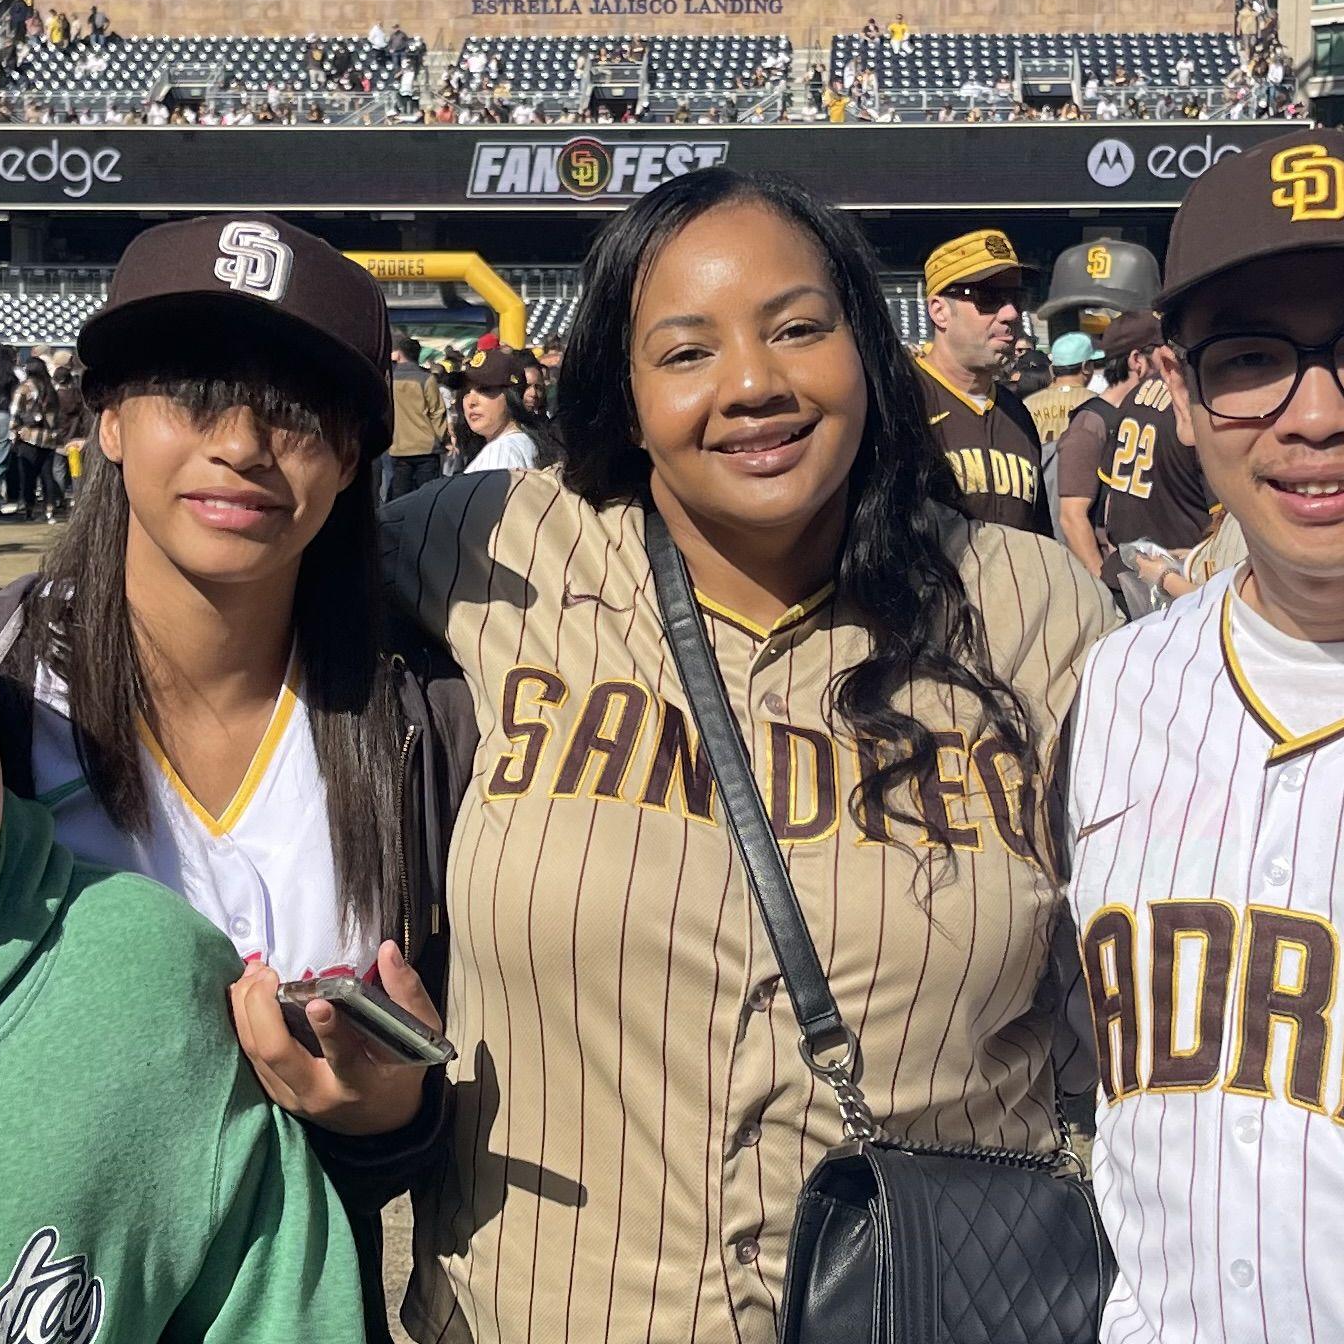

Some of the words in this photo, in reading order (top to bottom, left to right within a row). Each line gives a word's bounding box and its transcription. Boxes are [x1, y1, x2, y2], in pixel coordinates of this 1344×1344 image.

[472, 0, 581, 16] ESTRELLA
[472, 145, 560, 194] FAN
[607, 142, 727, 193] FEST
[368, 258, 426, 277] PADRES
[1033, 404, 1075, 422] MACH
[989, 447, 1037, 506] DIE
[1111, 416, 1158, 500] 22
[483, 662, 718, 827] SAN
